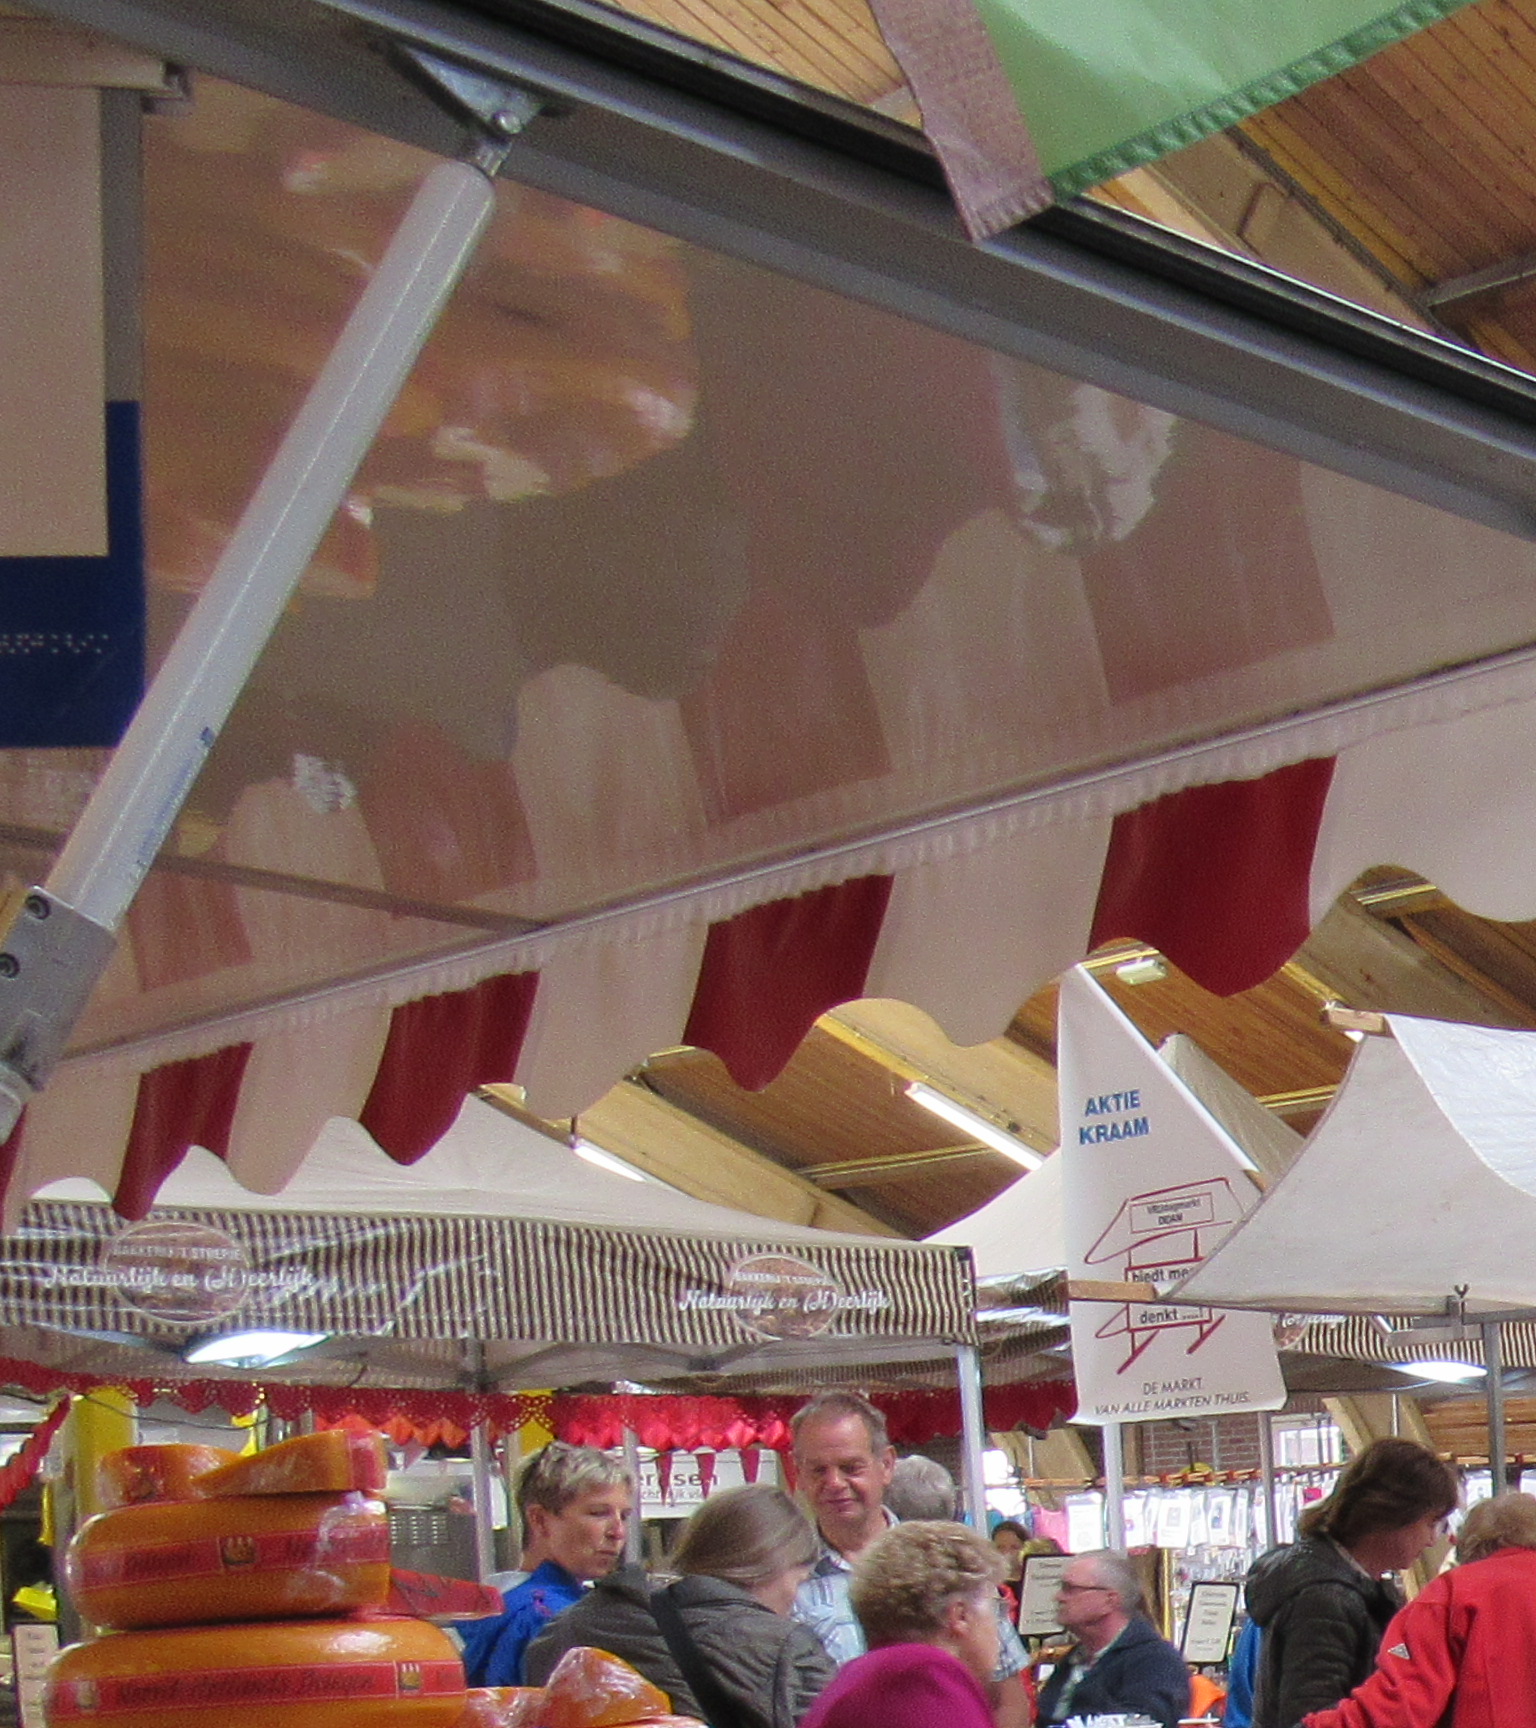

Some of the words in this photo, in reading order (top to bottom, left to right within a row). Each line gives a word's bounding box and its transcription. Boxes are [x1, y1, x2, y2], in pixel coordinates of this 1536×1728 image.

[1085, 1089, 1141, 1117] AKTIE
[1079, 1117, 1150, 1145] KRAAM
[43, 1266, 167, 1294] Natuurlijk
[171, 1272, 199, 1287] en
[679, 1289, 776, 1315] Natuurlijk
[778, 1296, 800, 1309] en
[1140, 1308, 1179, 1325] denkt
[1142, 1382, 1159, 1396] DE
[1095, 1401, 1119, 1416] VAN
[1120, 1398, 1149, 1414] ALLE
[1151, 1394, 1212, 1411] MARKTEN
